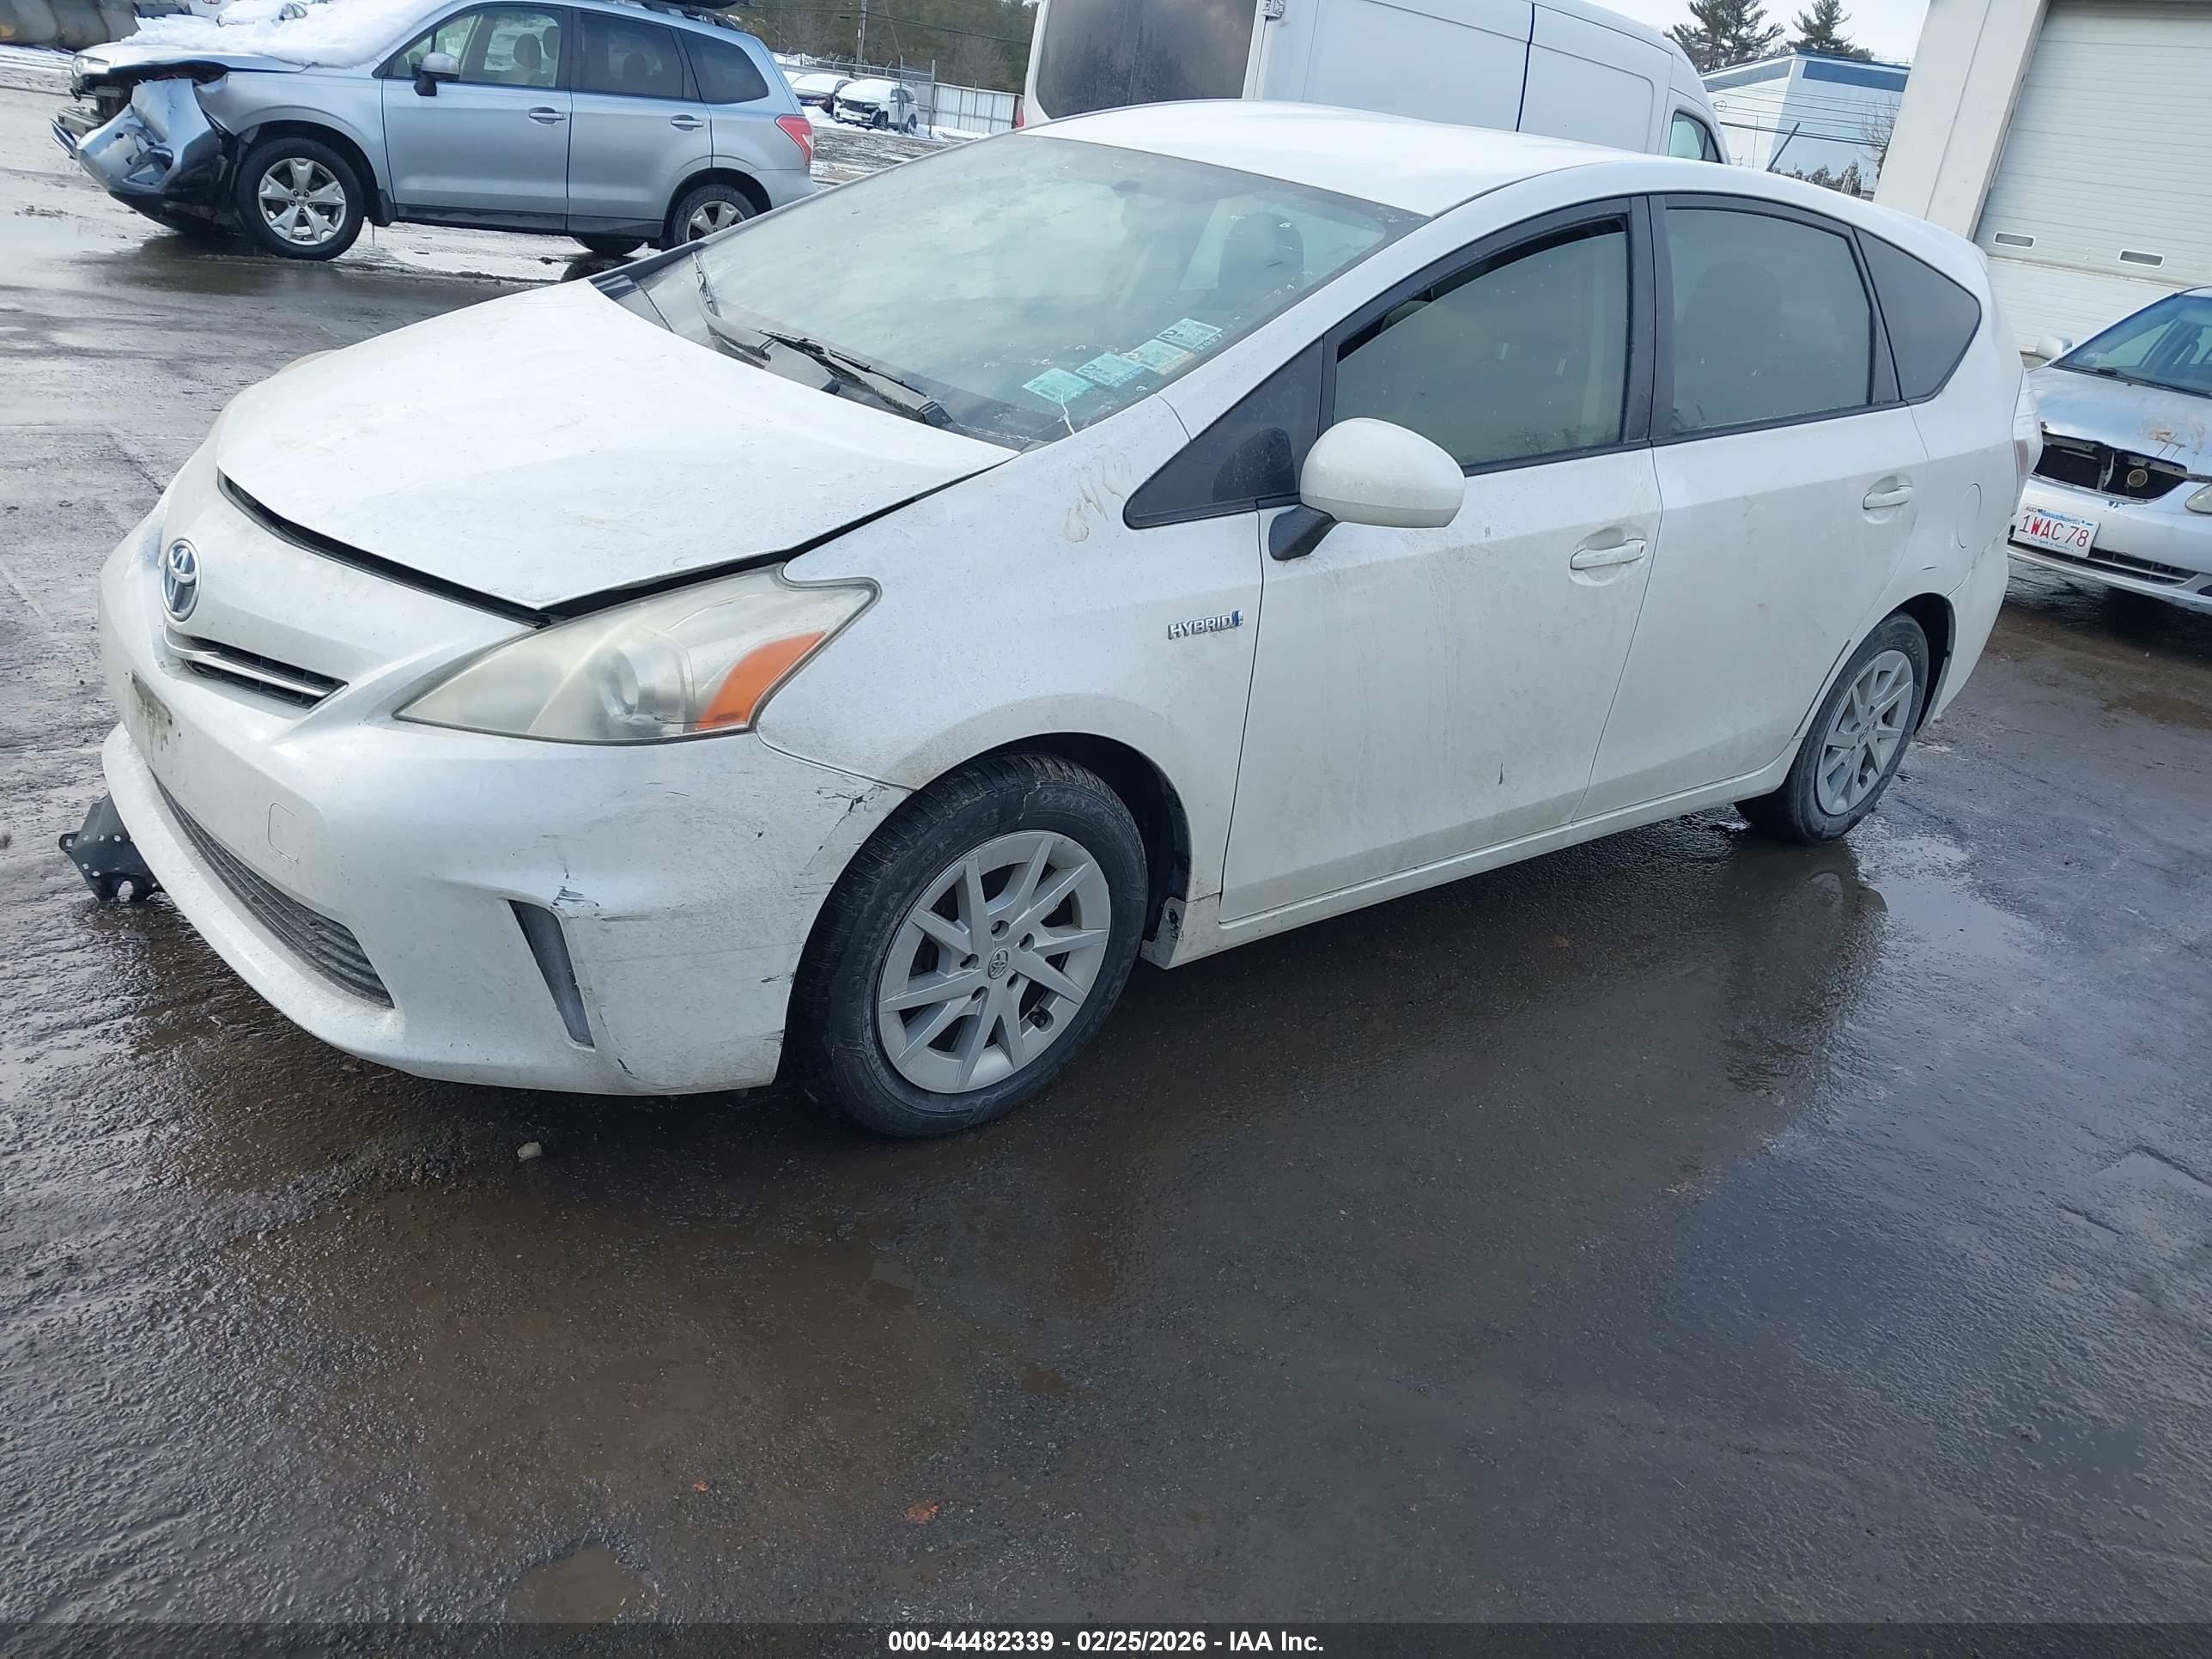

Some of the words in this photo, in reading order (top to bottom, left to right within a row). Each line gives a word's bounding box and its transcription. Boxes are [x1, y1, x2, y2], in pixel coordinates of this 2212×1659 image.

[2019, 515, 2063, 540] 1WAC
[2064, 526, 2089, 547] 78
[1168, 615, 1231, 640] HYBRID
